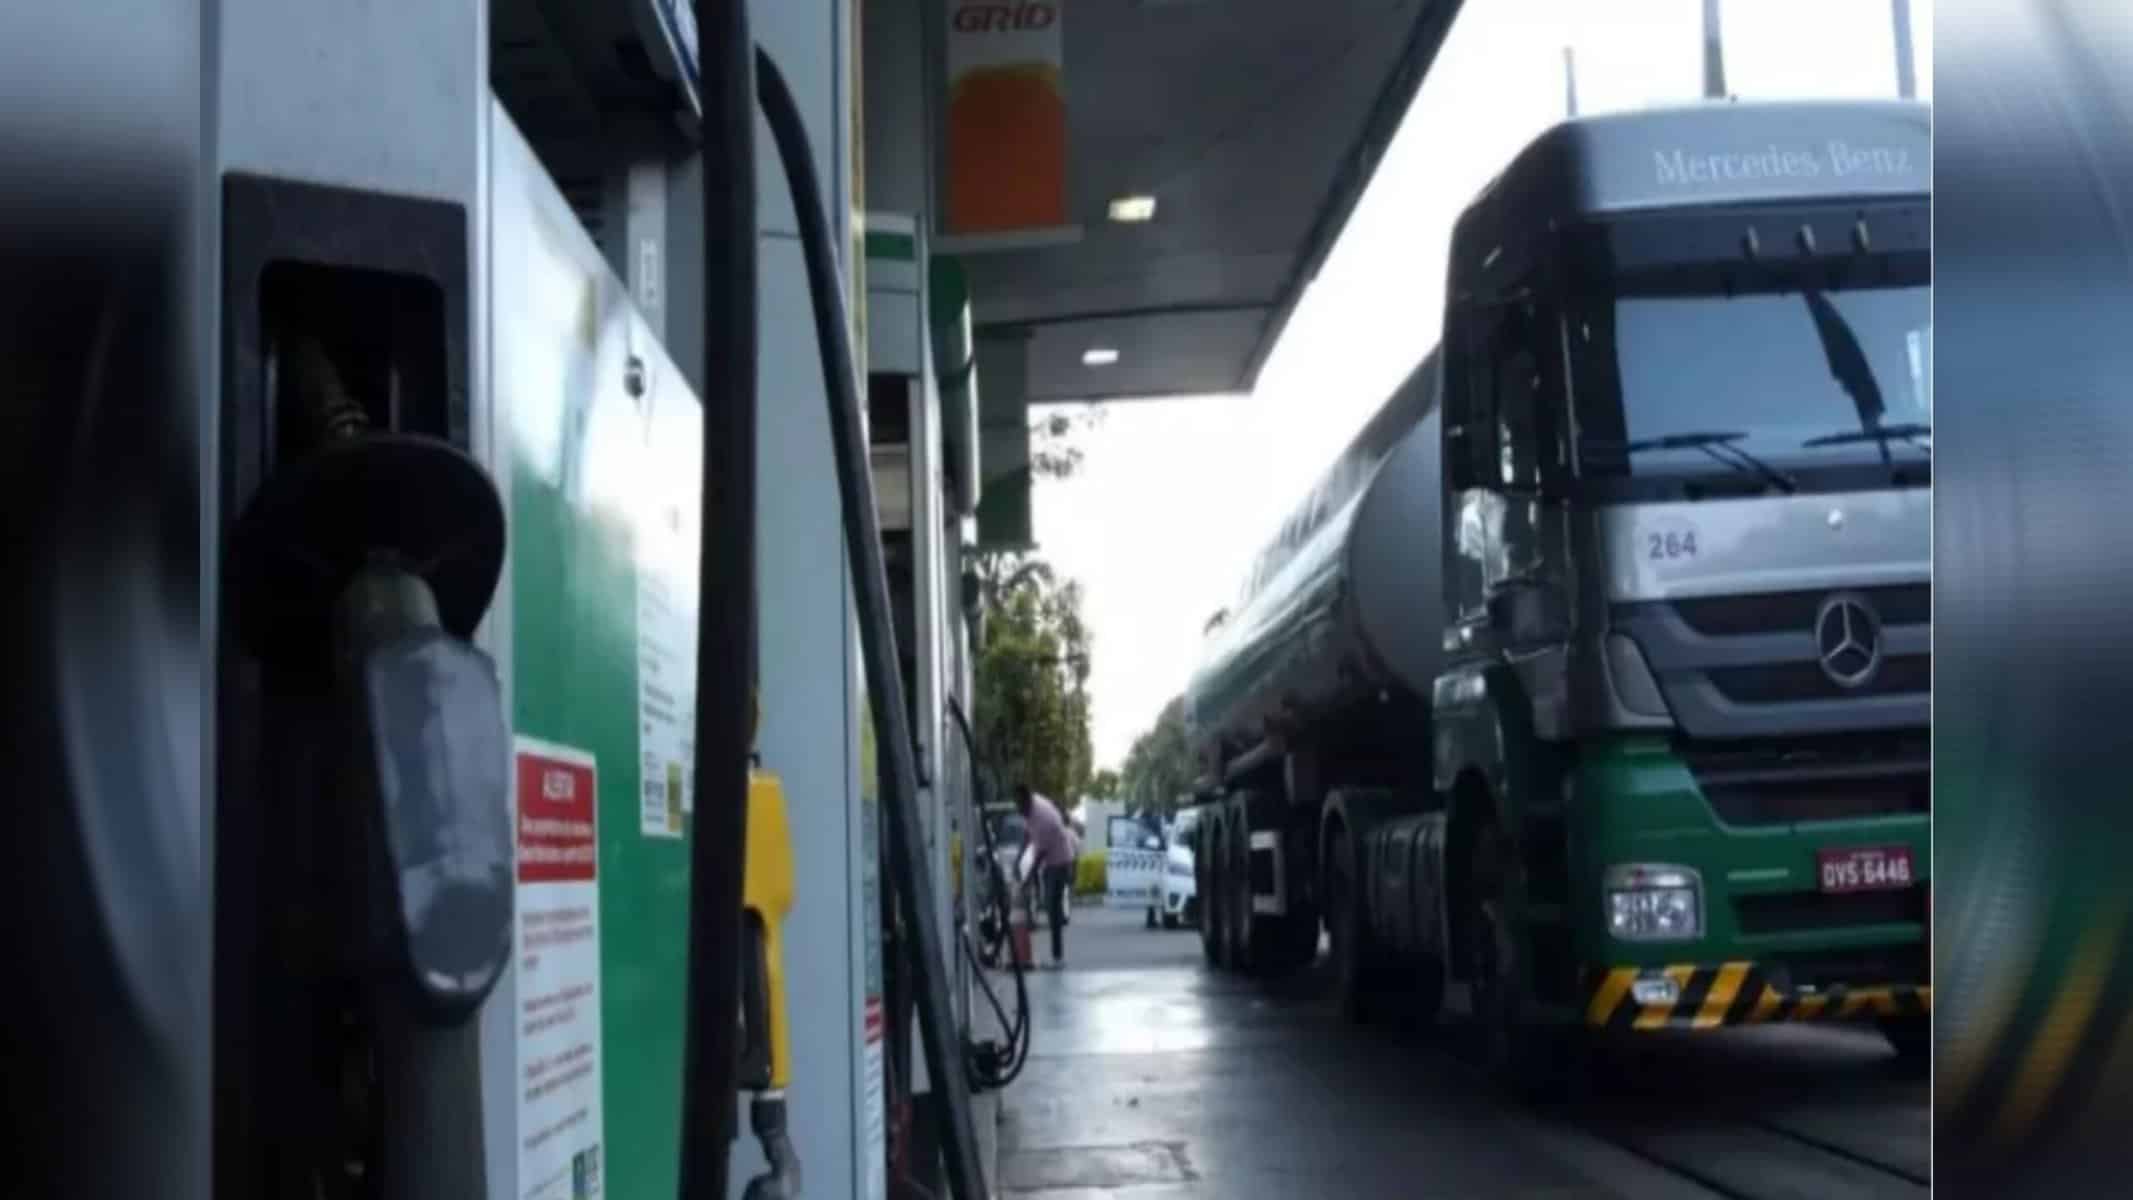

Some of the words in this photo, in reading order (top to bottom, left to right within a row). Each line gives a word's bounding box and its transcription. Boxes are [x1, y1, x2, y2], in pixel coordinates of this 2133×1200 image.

[1655, 143, 1820, 185] Mercedes
[1826, 138, 1912, 178] Benz
[1647, 531, 1697, 560] 264
